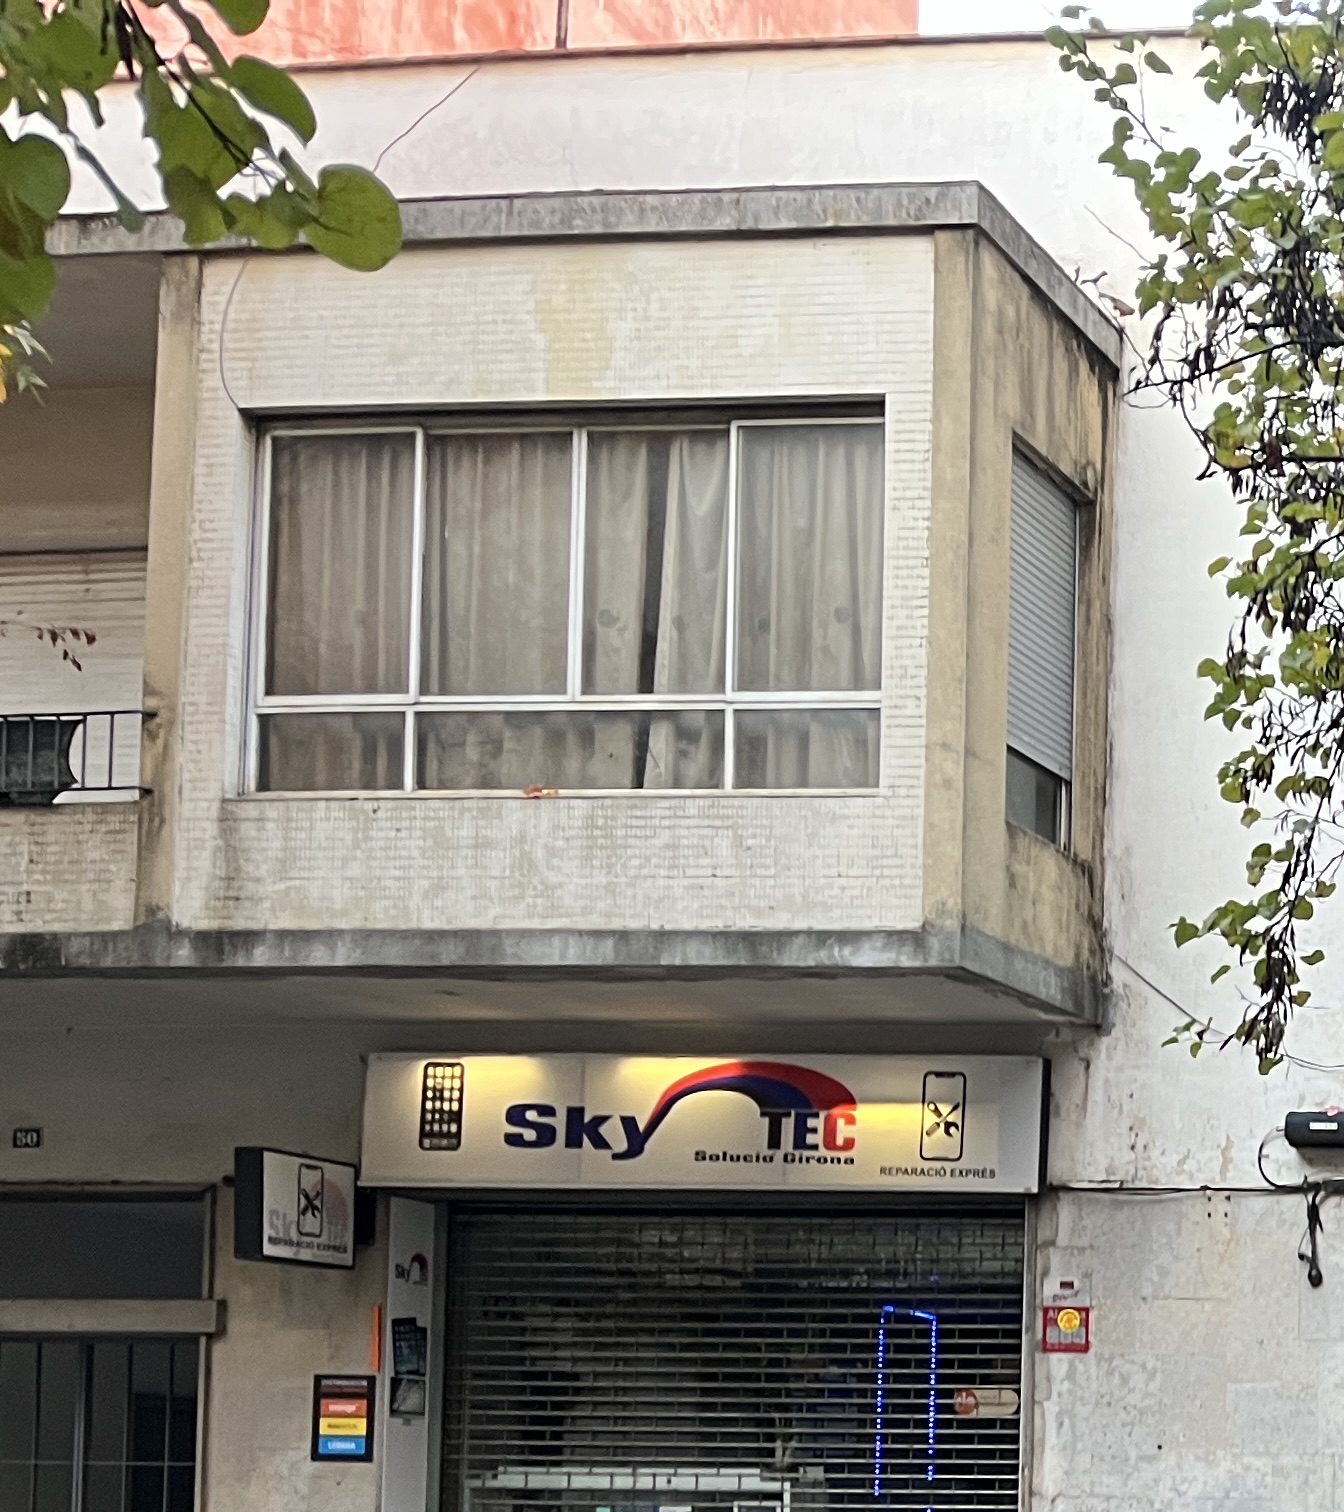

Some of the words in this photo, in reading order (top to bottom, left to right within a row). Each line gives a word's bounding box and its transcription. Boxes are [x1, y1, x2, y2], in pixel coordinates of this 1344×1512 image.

[16, 1131, 38, 1146] 50
[504, 1103, 647, 1161] Sky
[760, 1109, 857, 1151] TEC
[782, 1151, 856, 1166] Girona
